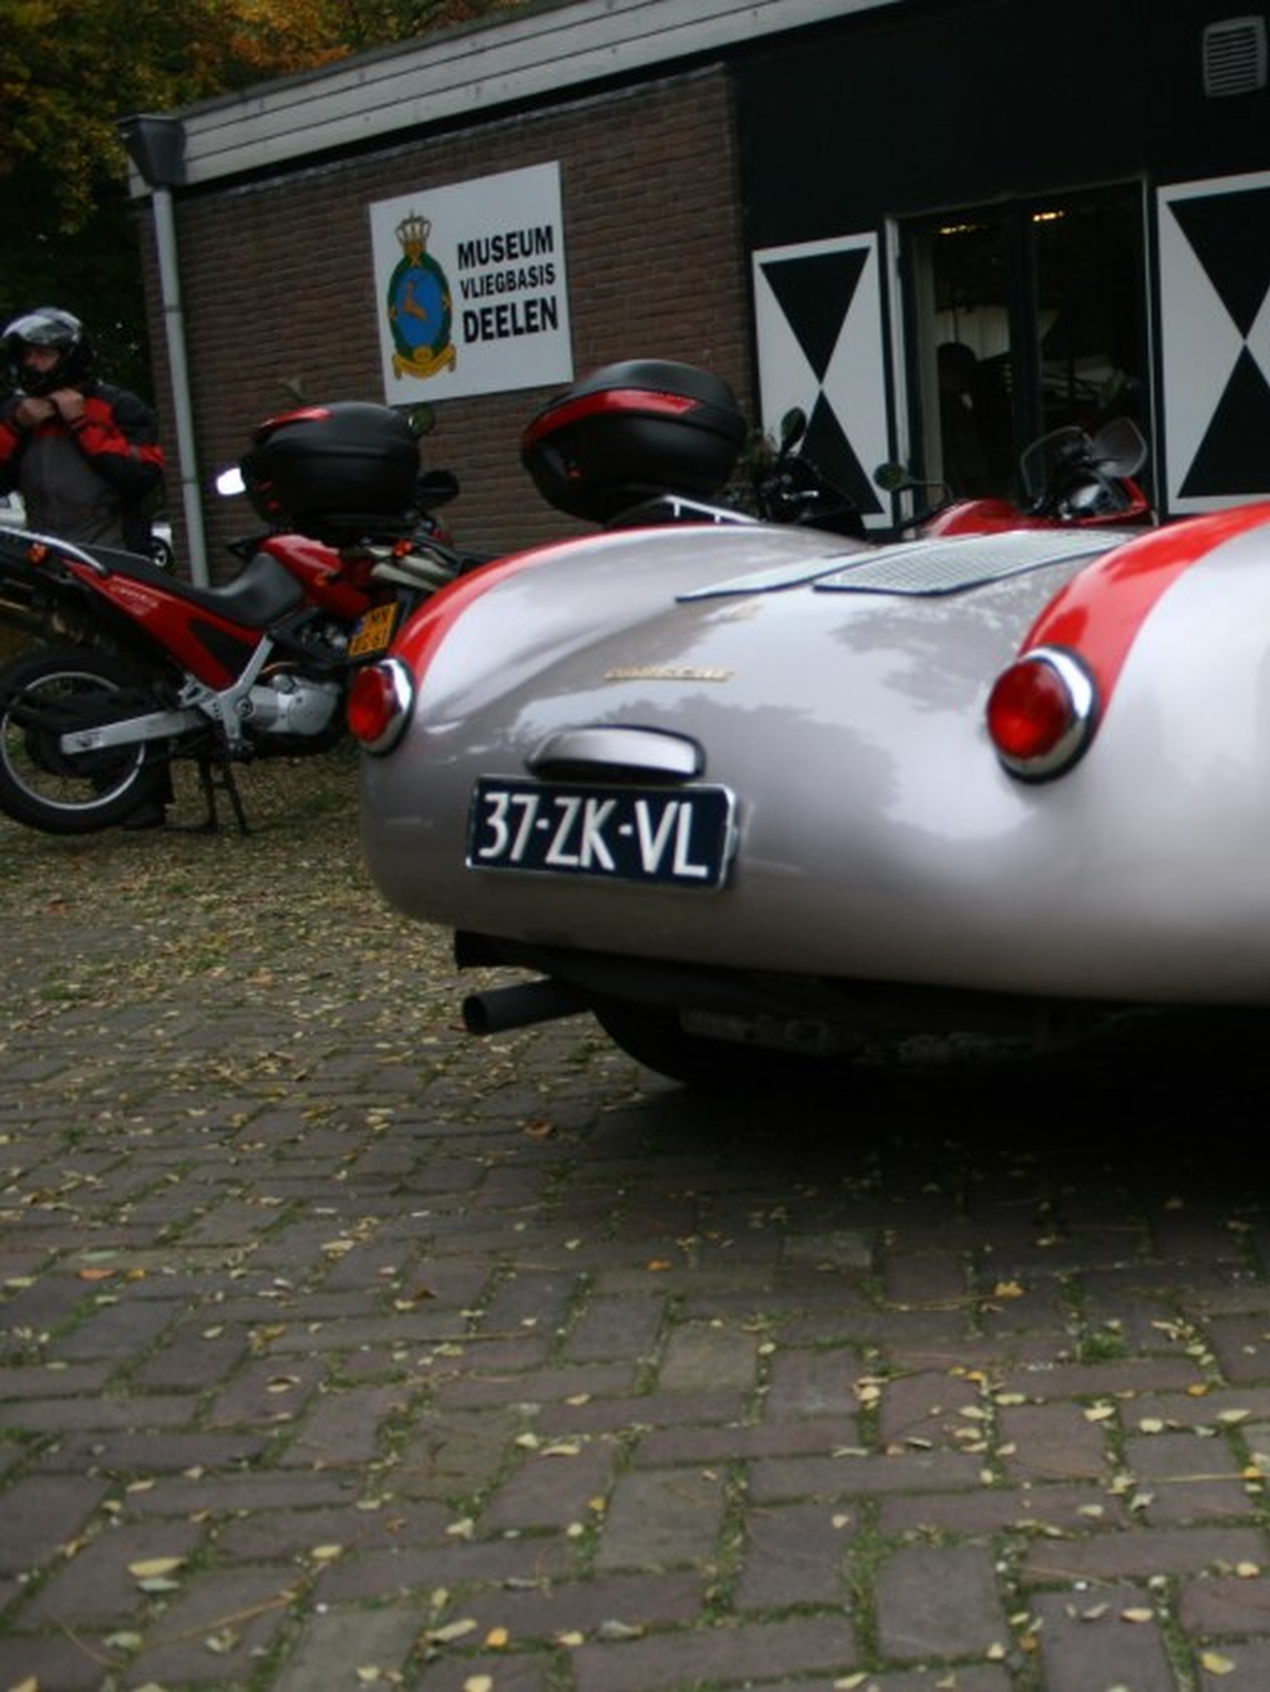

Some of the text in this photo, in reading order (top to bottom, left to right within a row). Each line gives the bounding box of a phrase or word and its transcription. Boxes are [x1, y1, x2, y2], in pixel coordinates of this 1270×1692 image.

[457, 225, 554, 271] MUSEUM
[460, 263, 556, 299] VLIEGBASIS
[463, 296, 559, 344] DEELEN
[478, 792, 709, 879] 37-ZK-VL
